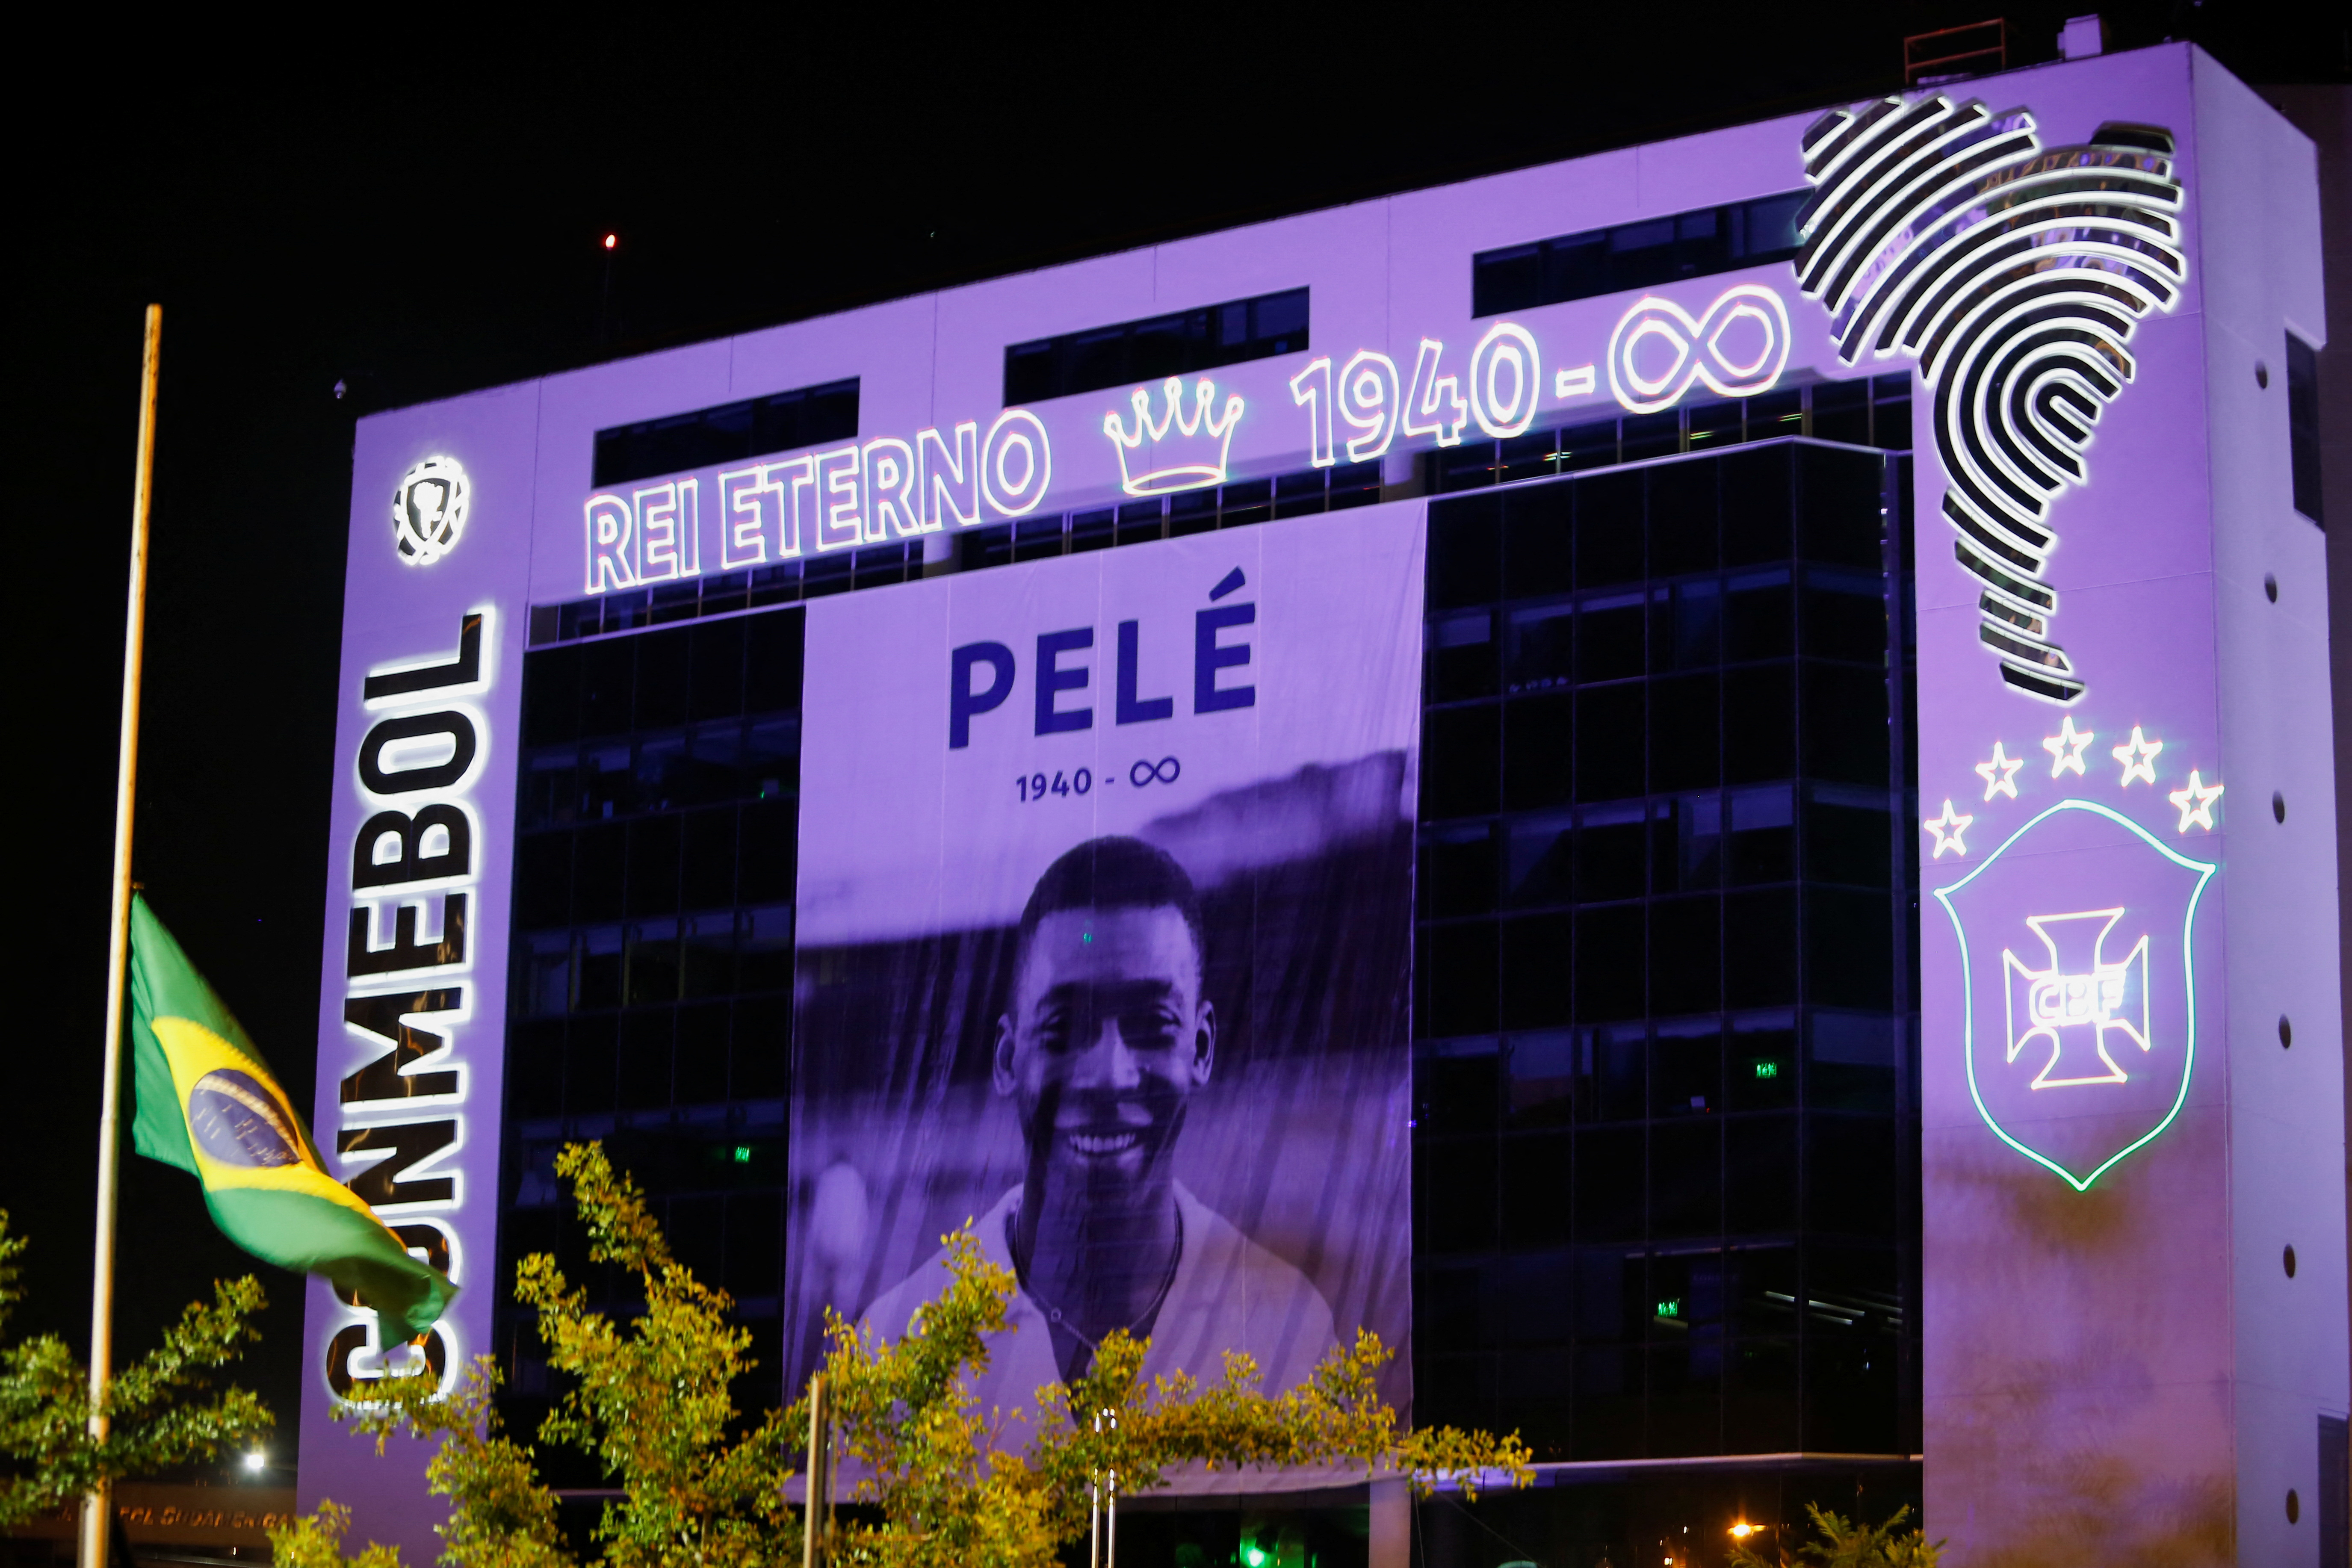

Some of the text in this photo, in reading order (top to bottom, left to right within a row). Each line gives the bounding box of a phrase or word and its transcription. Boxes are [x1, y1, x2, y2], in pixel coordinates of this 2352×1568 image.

[585, 477, 700, 595] REI
[719, 409, 1052, 570] ETERNO
[1290, 322, 1540, 468] 1940
[948, 565, 1256, 750] PELÉ
[1016, 768, 1091, 803] 1940
[2030, 969, 2127, 1027] CBF
